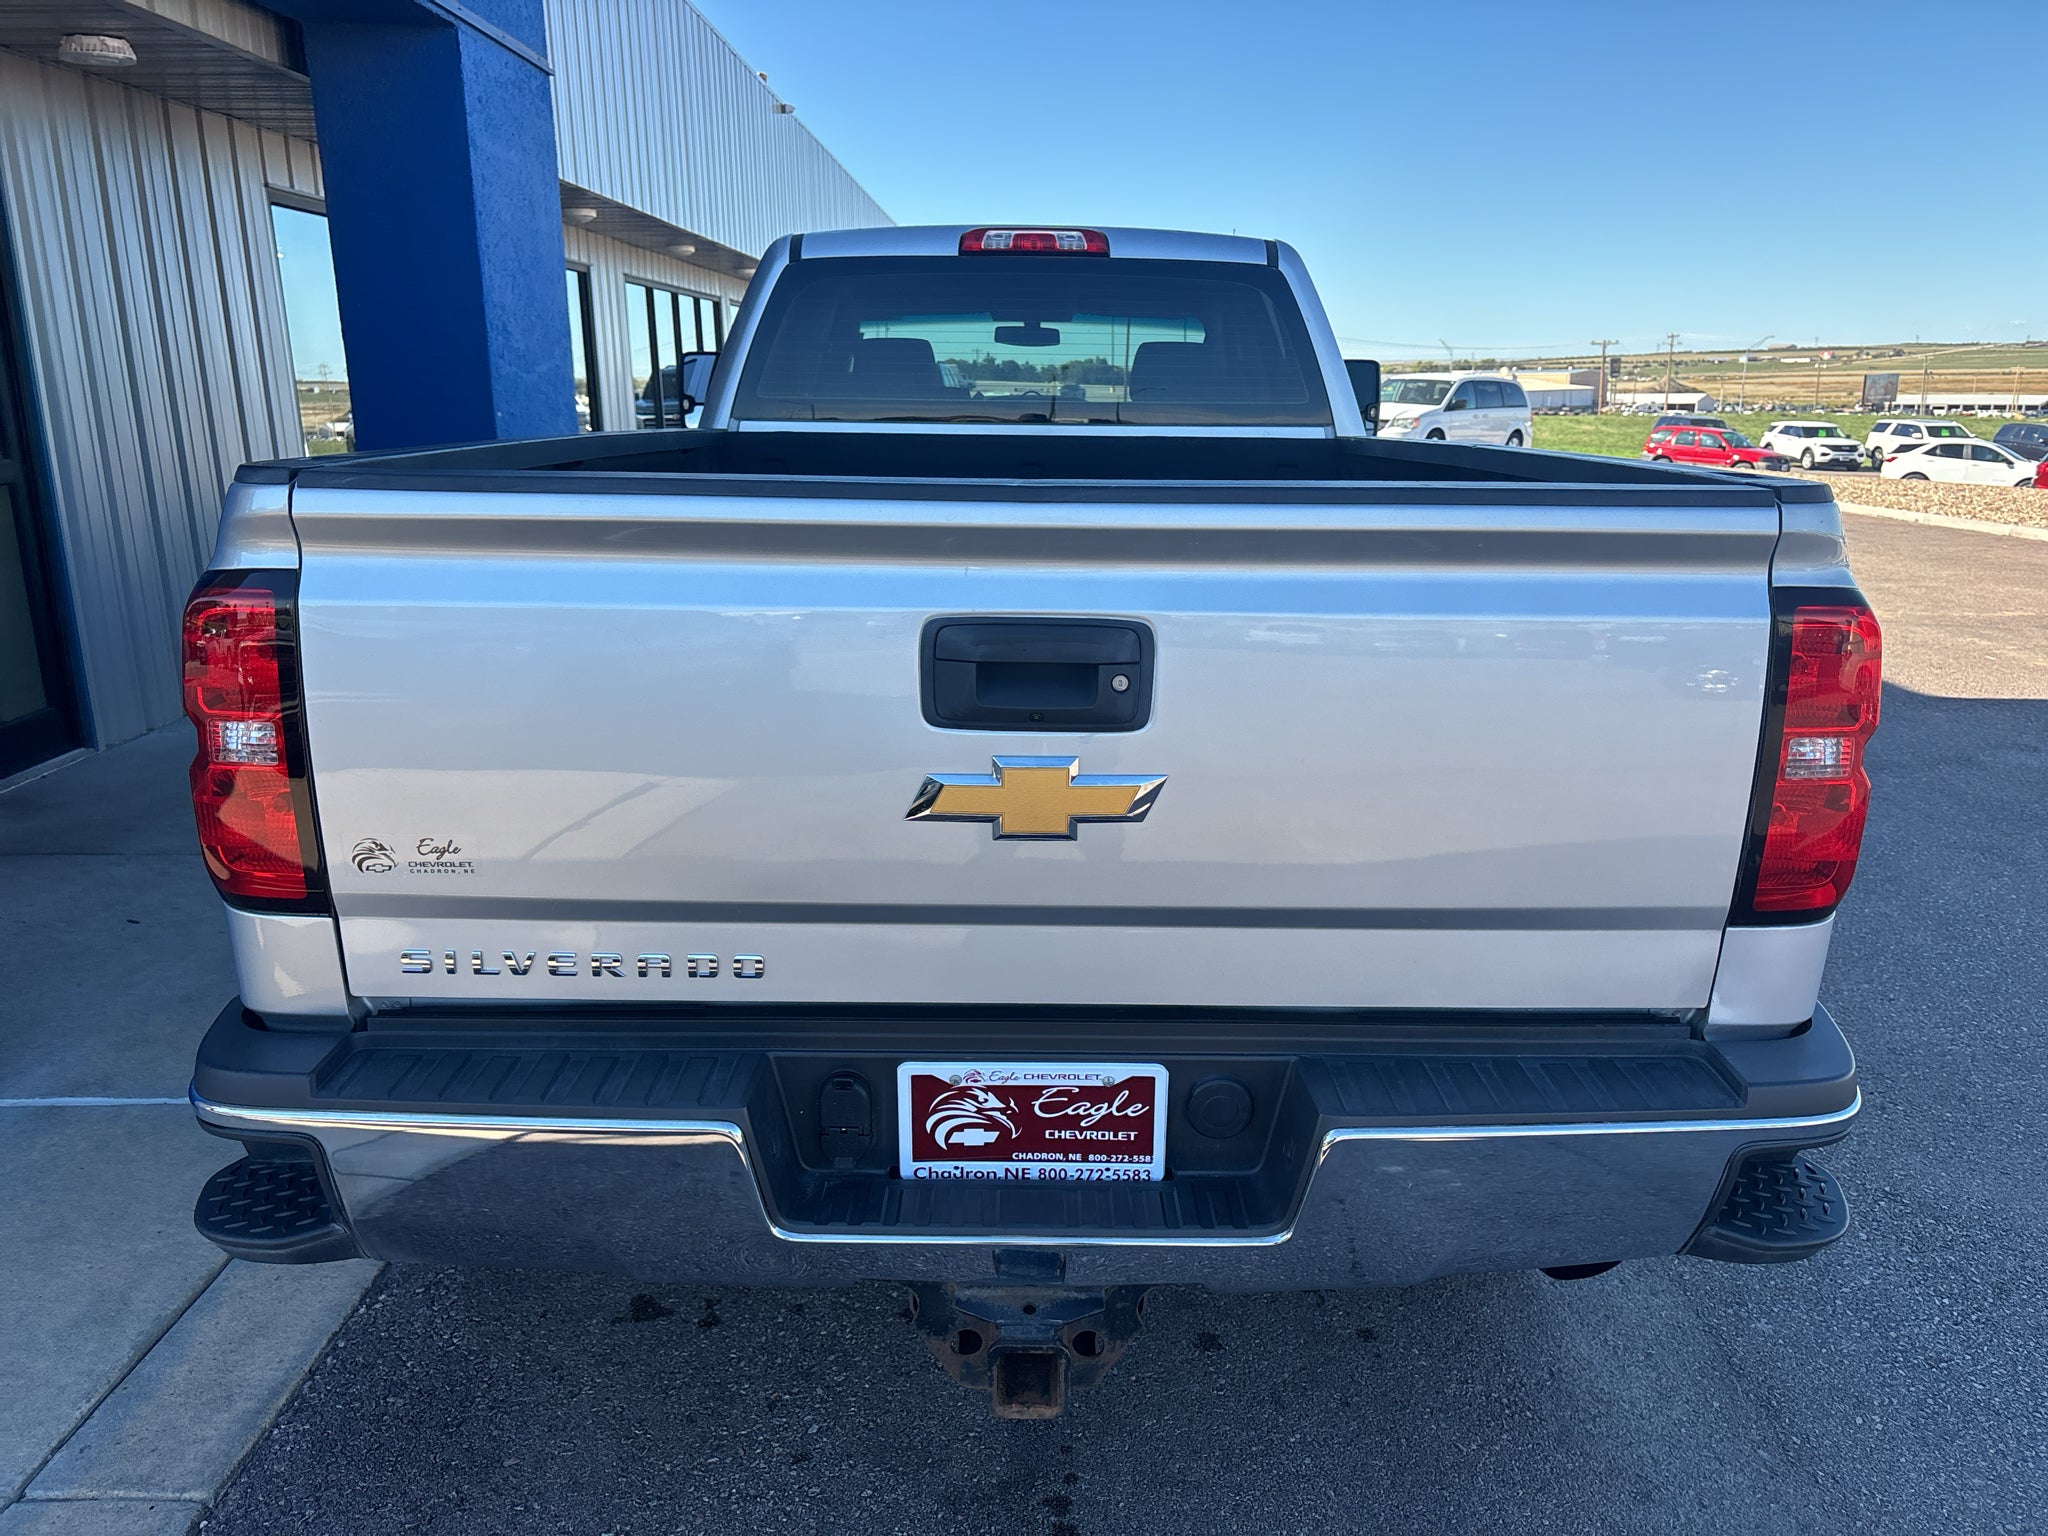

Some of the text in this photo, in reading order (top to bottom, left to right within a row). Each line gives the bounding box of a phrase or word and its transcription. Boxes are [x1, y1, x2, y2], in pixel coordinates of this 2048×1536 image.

[416, 837, 461, 860] Eagle
[400, 948, 766, 979] SILVERADO
[988, 1070, 1101, 1084] Eagle CHEVROLET
[1031, 1087, 1150, 1127] Eagle
[1044, 1129, 1139, 1141] CHEVROLET
[1012, 1152, 1153, 1163] CHADRON, NE 800-272-558
[1037, 1167, 1151, 1181] 800-272-5583
